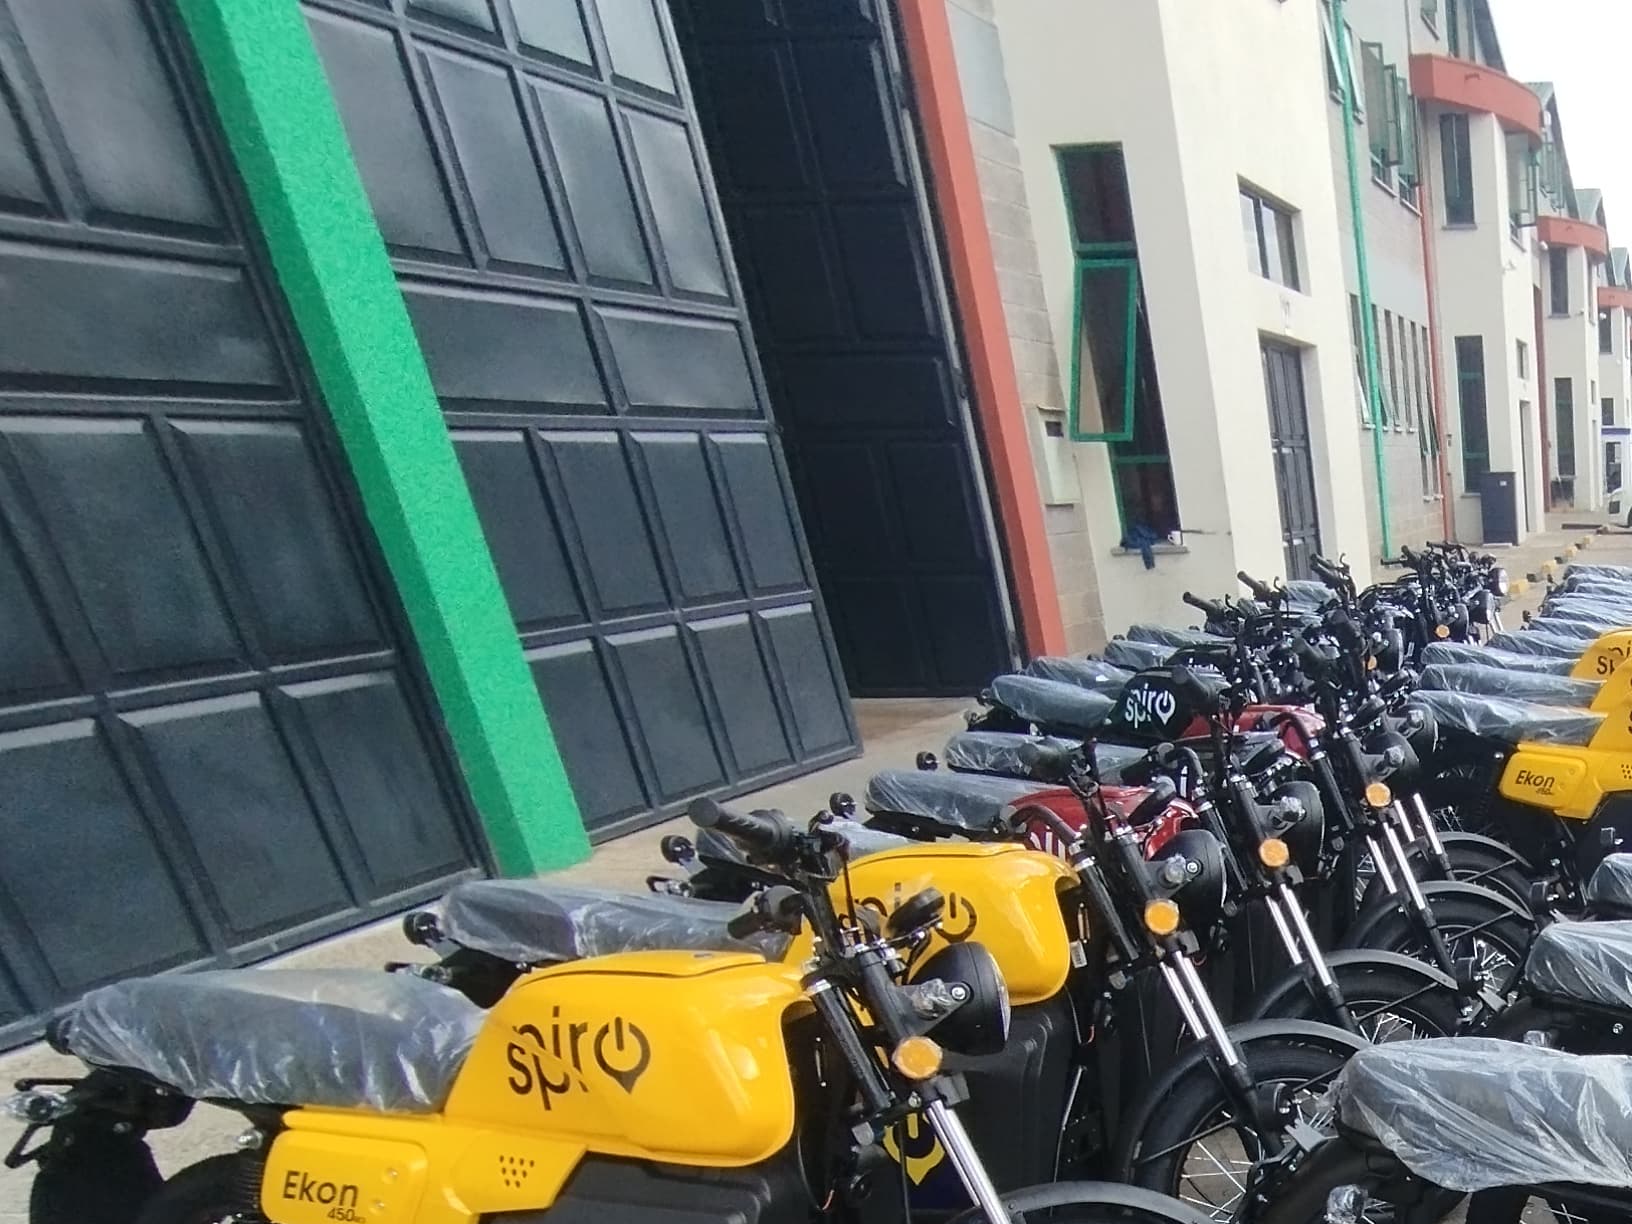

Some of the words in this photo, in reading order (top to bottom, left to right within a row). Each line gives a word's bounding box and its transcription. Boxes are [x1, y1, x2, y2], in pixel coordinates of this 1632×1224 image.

[1125, 683, 1176, 729] spiro
[1515, 770, 1555, 788] Ekon
[507, 1005, 651, 1111] spiro
[283, 1170, 359, 1207] Ekon
